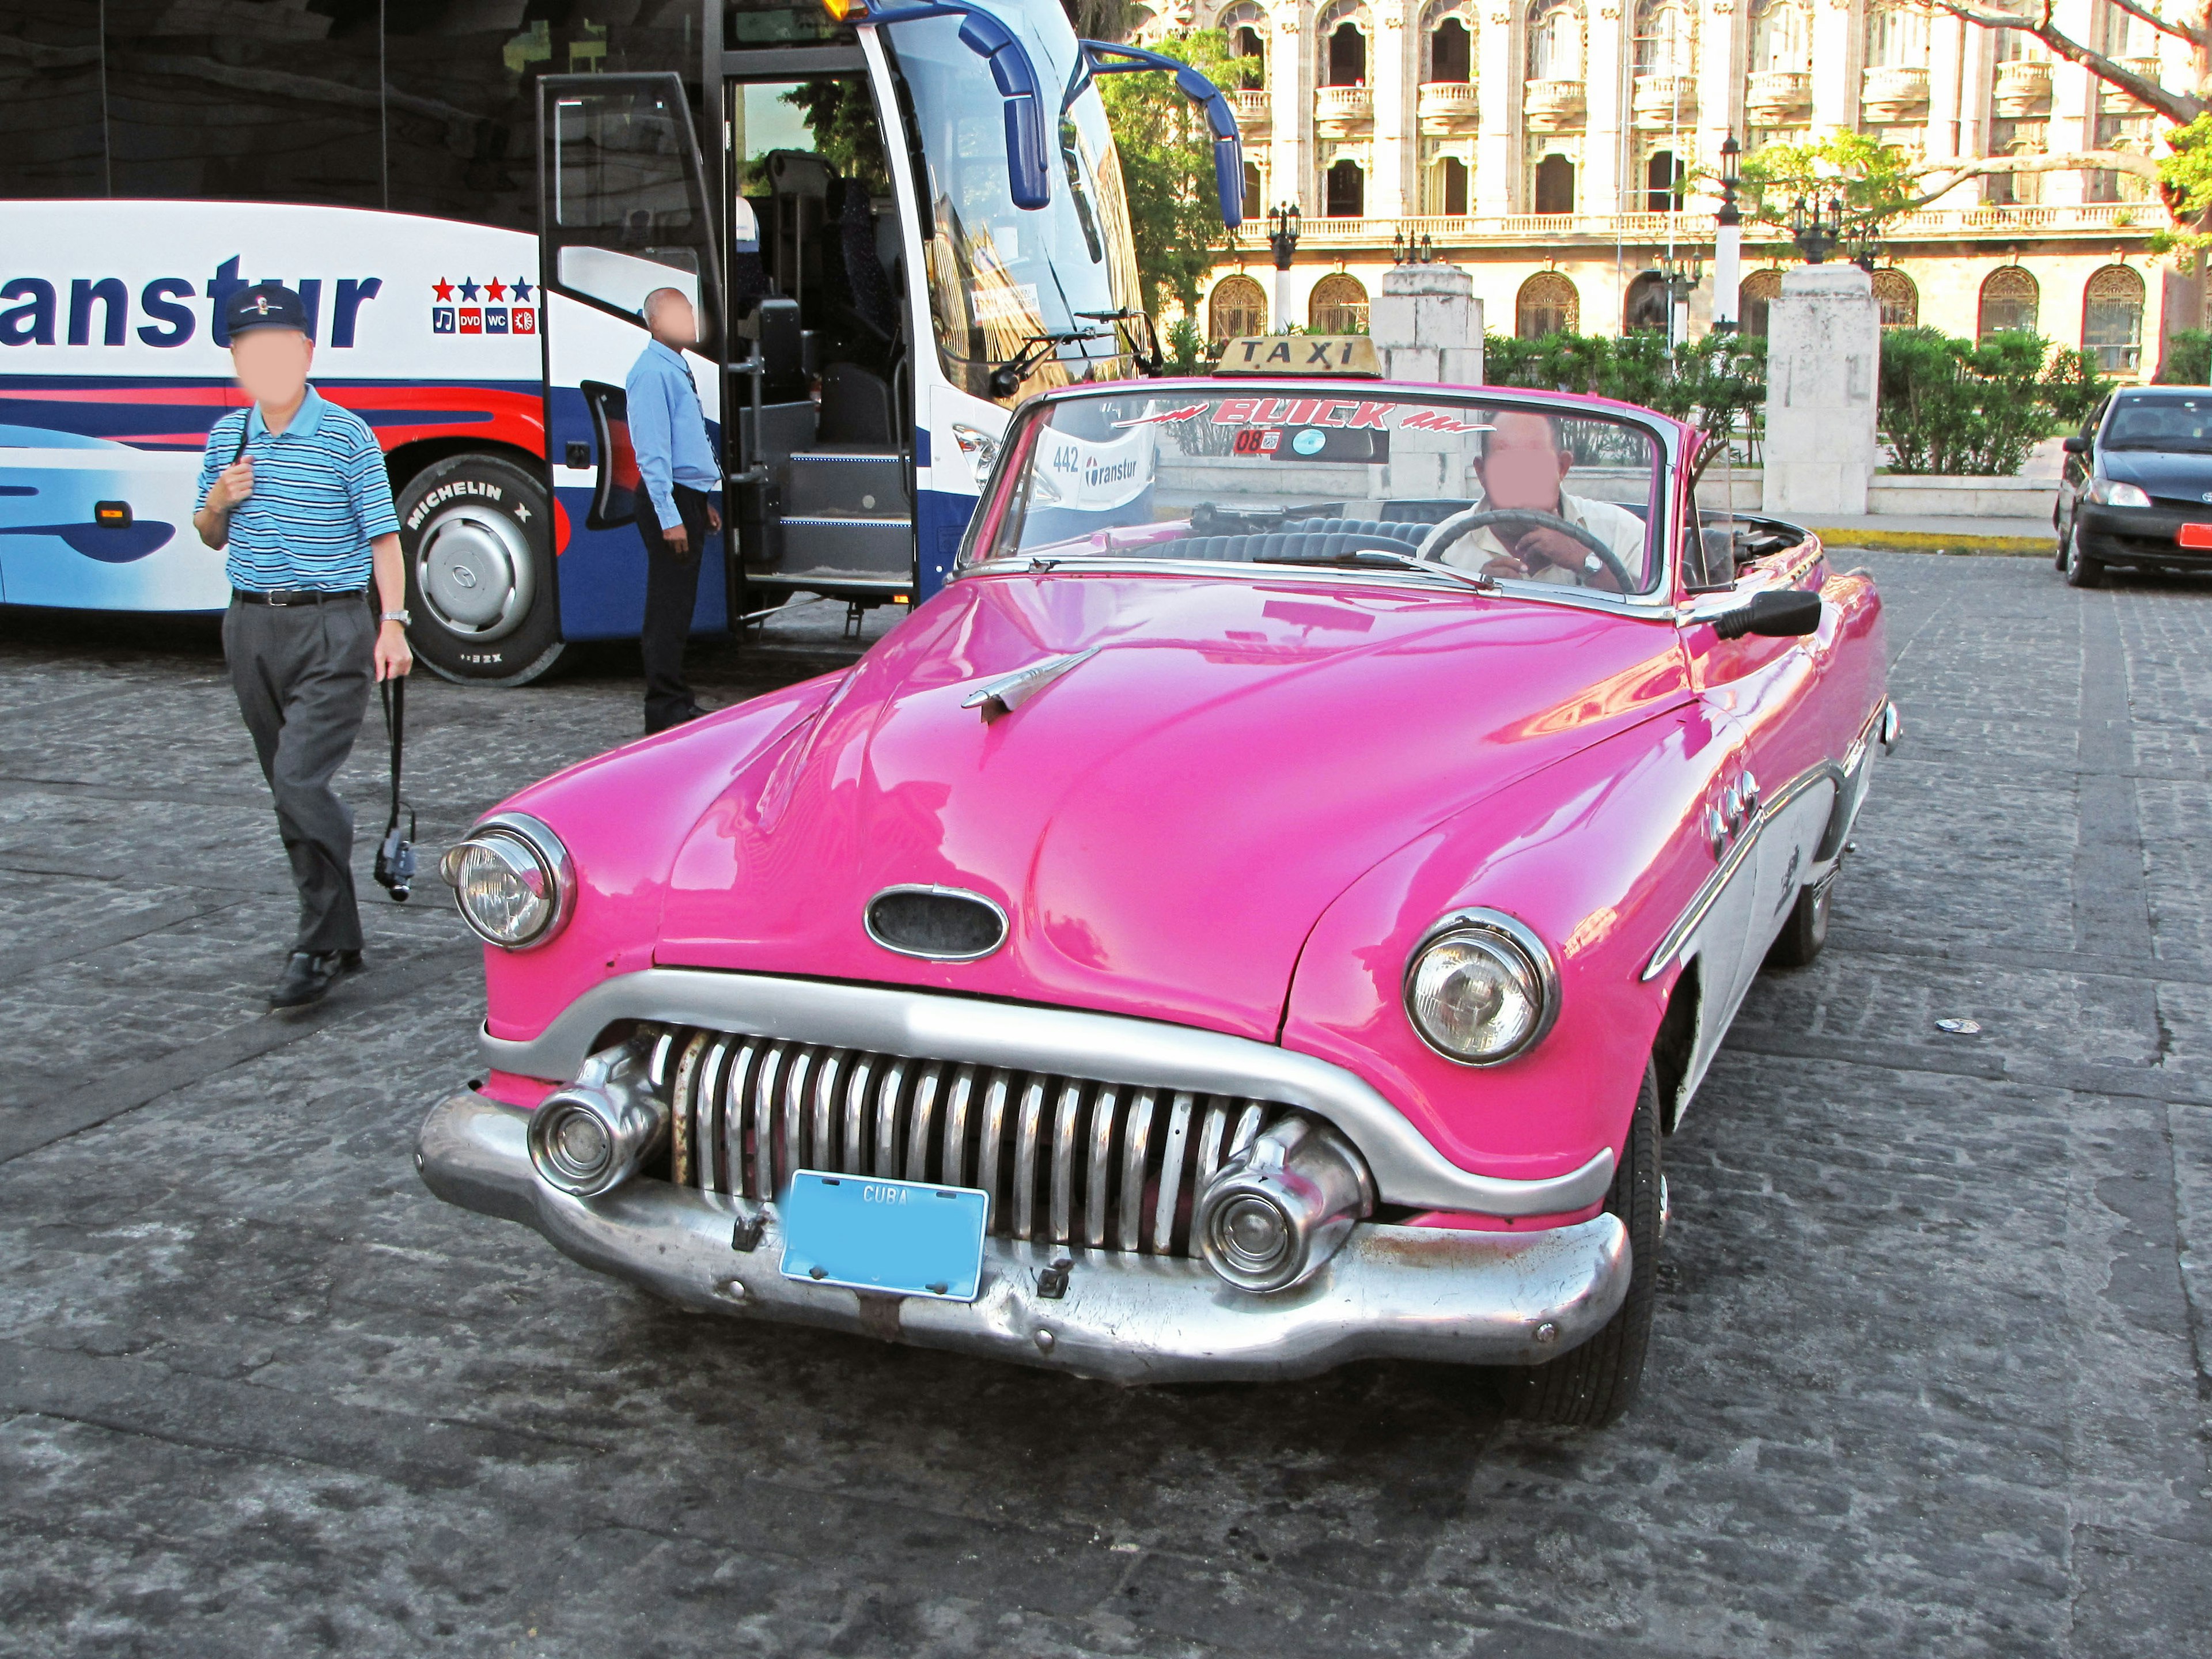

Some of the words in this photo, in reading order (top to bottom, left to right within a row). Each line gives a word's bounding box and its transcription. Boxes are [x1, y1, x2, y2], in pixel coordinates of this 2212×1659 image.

[460, 316, 480, 326] DVD
[487, 315, 506, 326] WC
[1241, 341, 1353, 365] TAXI
[1210, 398, 1396, 431] BUICK
[1237, 430, 1263, 452] 08
[1054, 446, 1078, 472] 442
[407, 481, 502, 530] MICHELIN
[514, 502, 532, 523] X
[863, 1185, 907, 1207] CUBA
